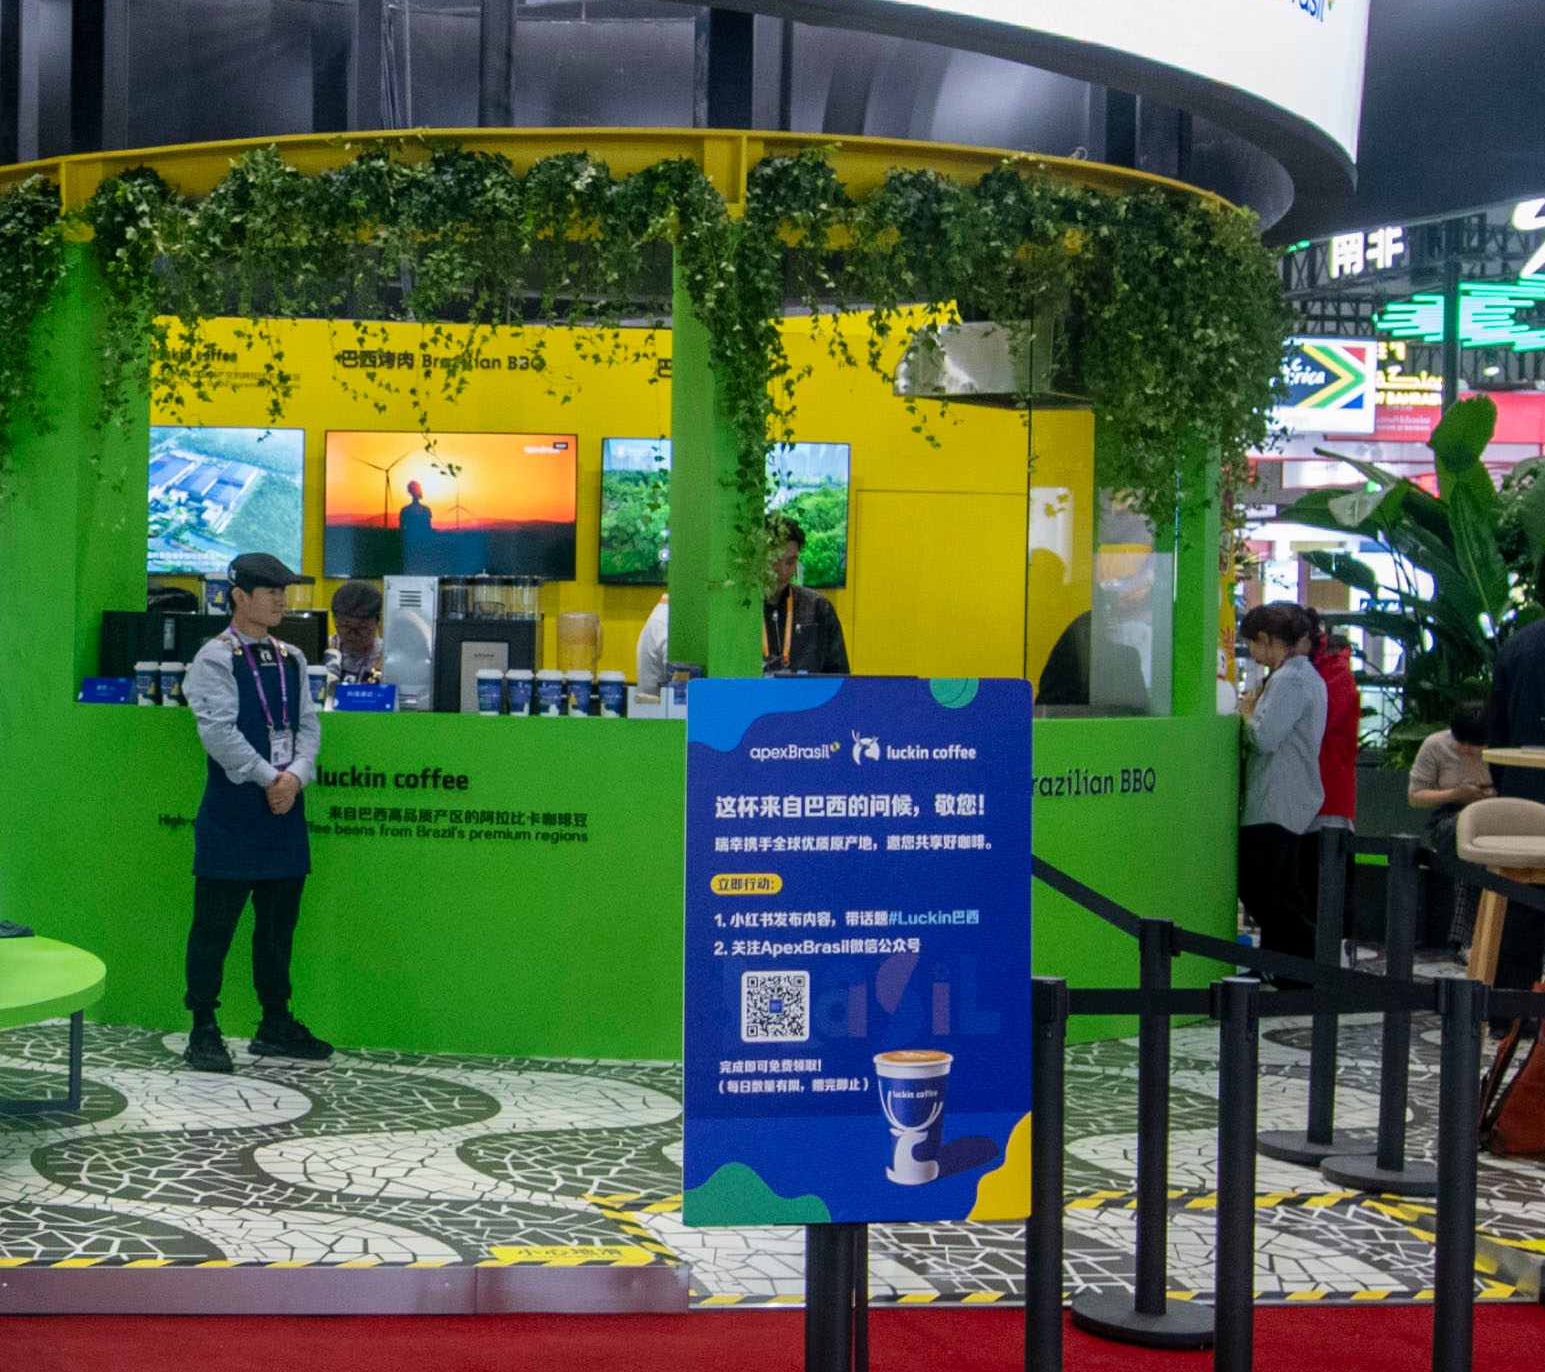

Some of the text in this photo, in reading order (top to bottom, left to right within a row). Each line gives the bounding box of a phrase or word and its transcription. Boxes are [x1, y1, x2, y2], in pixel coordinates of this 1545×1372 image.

[1330, 226, 1405, 278] 南非
[750, 743, 977, 762] apexBrasil luckin coffee
[316, 765, 469, 790] luckin coffee
[1032, 767, 1157, 796] razilian BBQ
[380, 824, 412, 838] from
[468, 827, 531, 843] premium
[535, 828, 589, 844] regions
